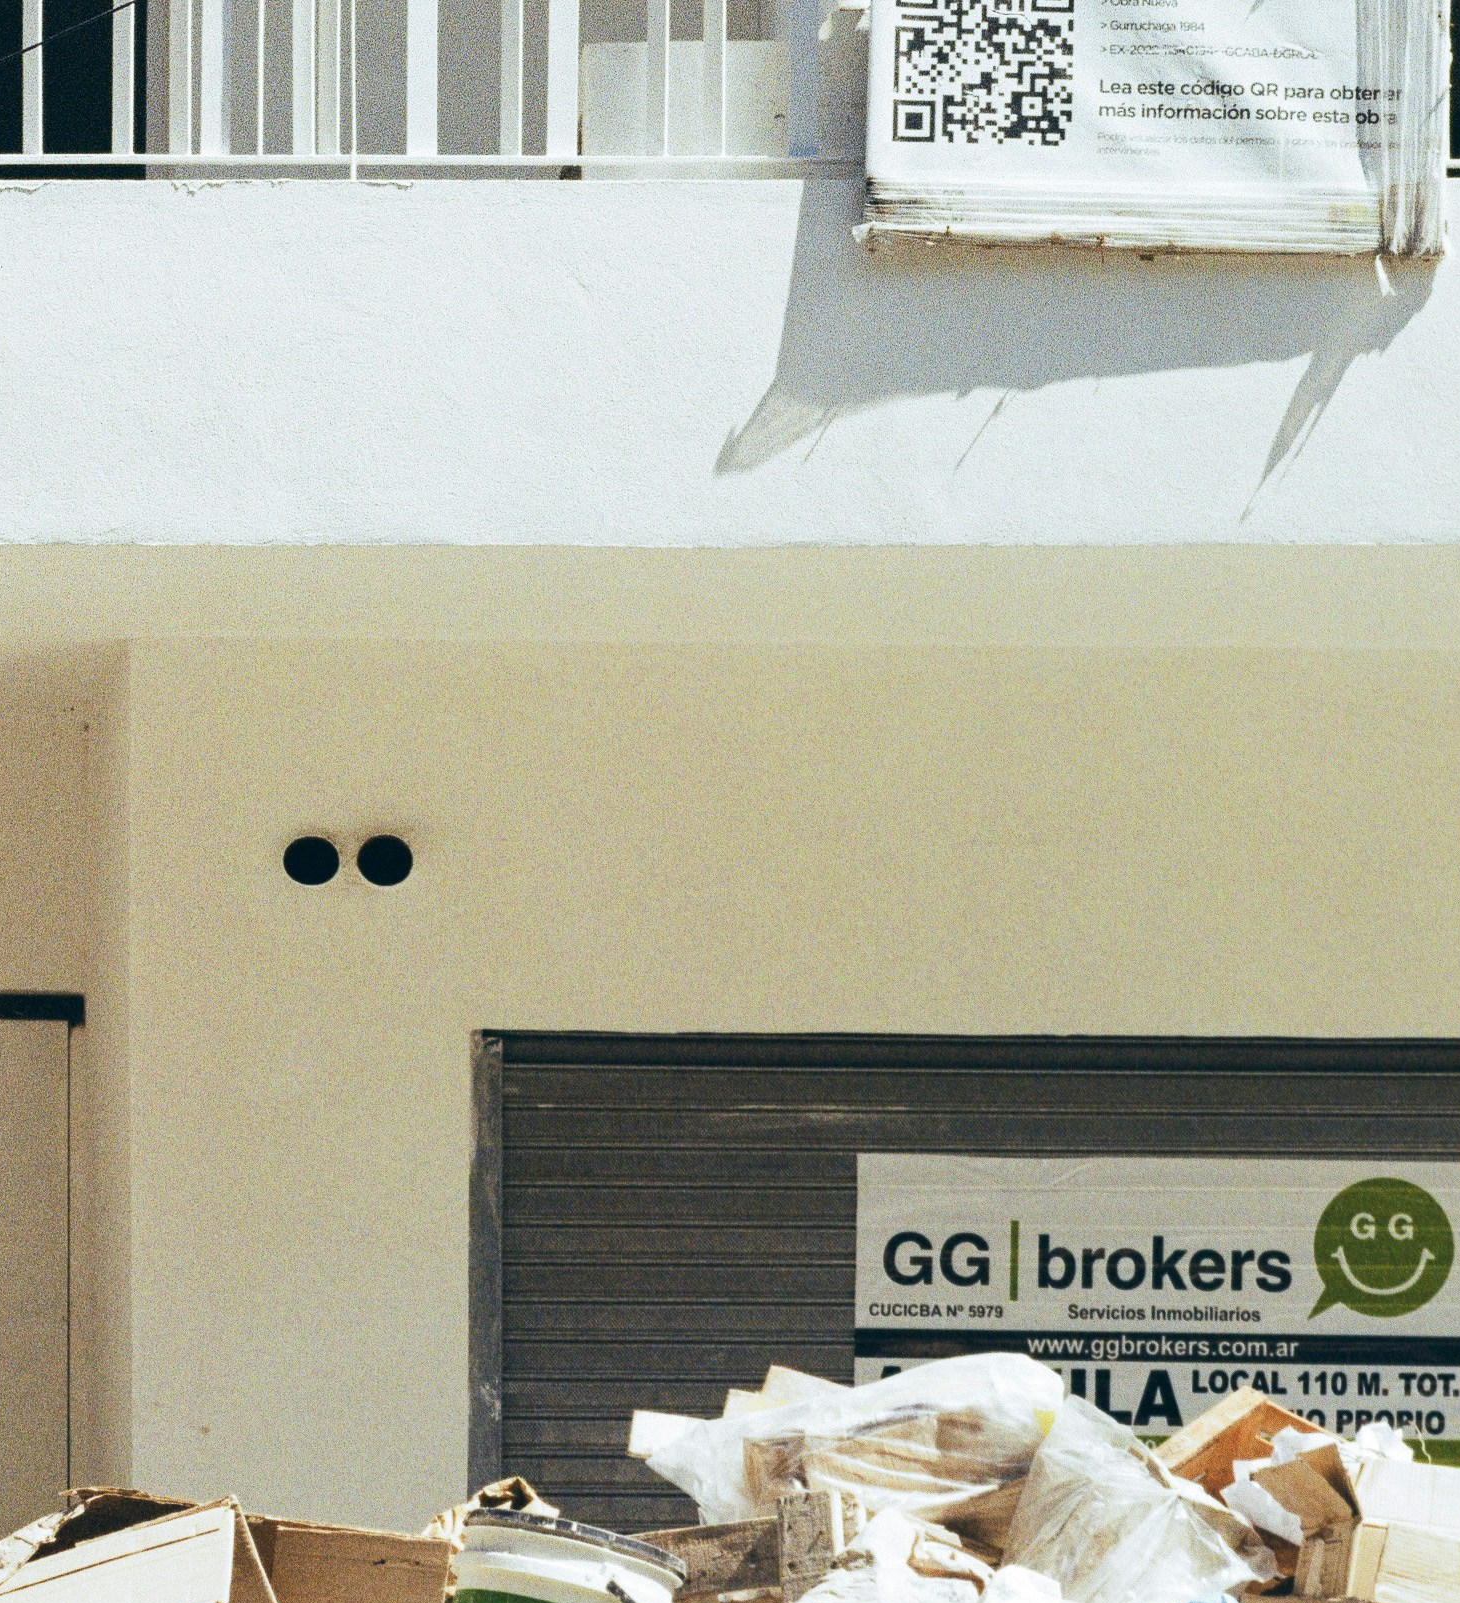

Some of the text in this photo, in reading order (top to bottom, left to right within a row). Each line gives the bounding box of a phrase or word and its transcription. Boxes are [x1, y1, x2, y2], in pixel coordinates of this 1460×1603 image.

[1099, 79, 1132, 96] Lea
[1137, 81, 1175, 97] este
[1180, 79, 1245, 101] código
[1250, 82, 1278, 98] QR
[1284, 86, 1325, 101] para
[1098, 103, 1136, 119] más
[1141, 103, 1251, 121] información
[1255, 106, 1308, 123] sobre
[1312, 109, 1350, 124] esta
[881, 1230, 1293, 1293] GG brokers
[868, 1302, 941, 1318] CUCICBA
[968, 1303, 1004, 1319] 5979
[1067, 1303, 1261, 1323] Servicios Inmobiliarios
[1027, 1335, 1299, 1361] www.ggbrokers.com.ar
[1191, 1369, 1288, 1396] LOCAL
[1297, 1370, 1348, 1396] 110
[1357, 1371, 1390, 1397] M.
[1398, 1372, 1460, 1398] TOT.
